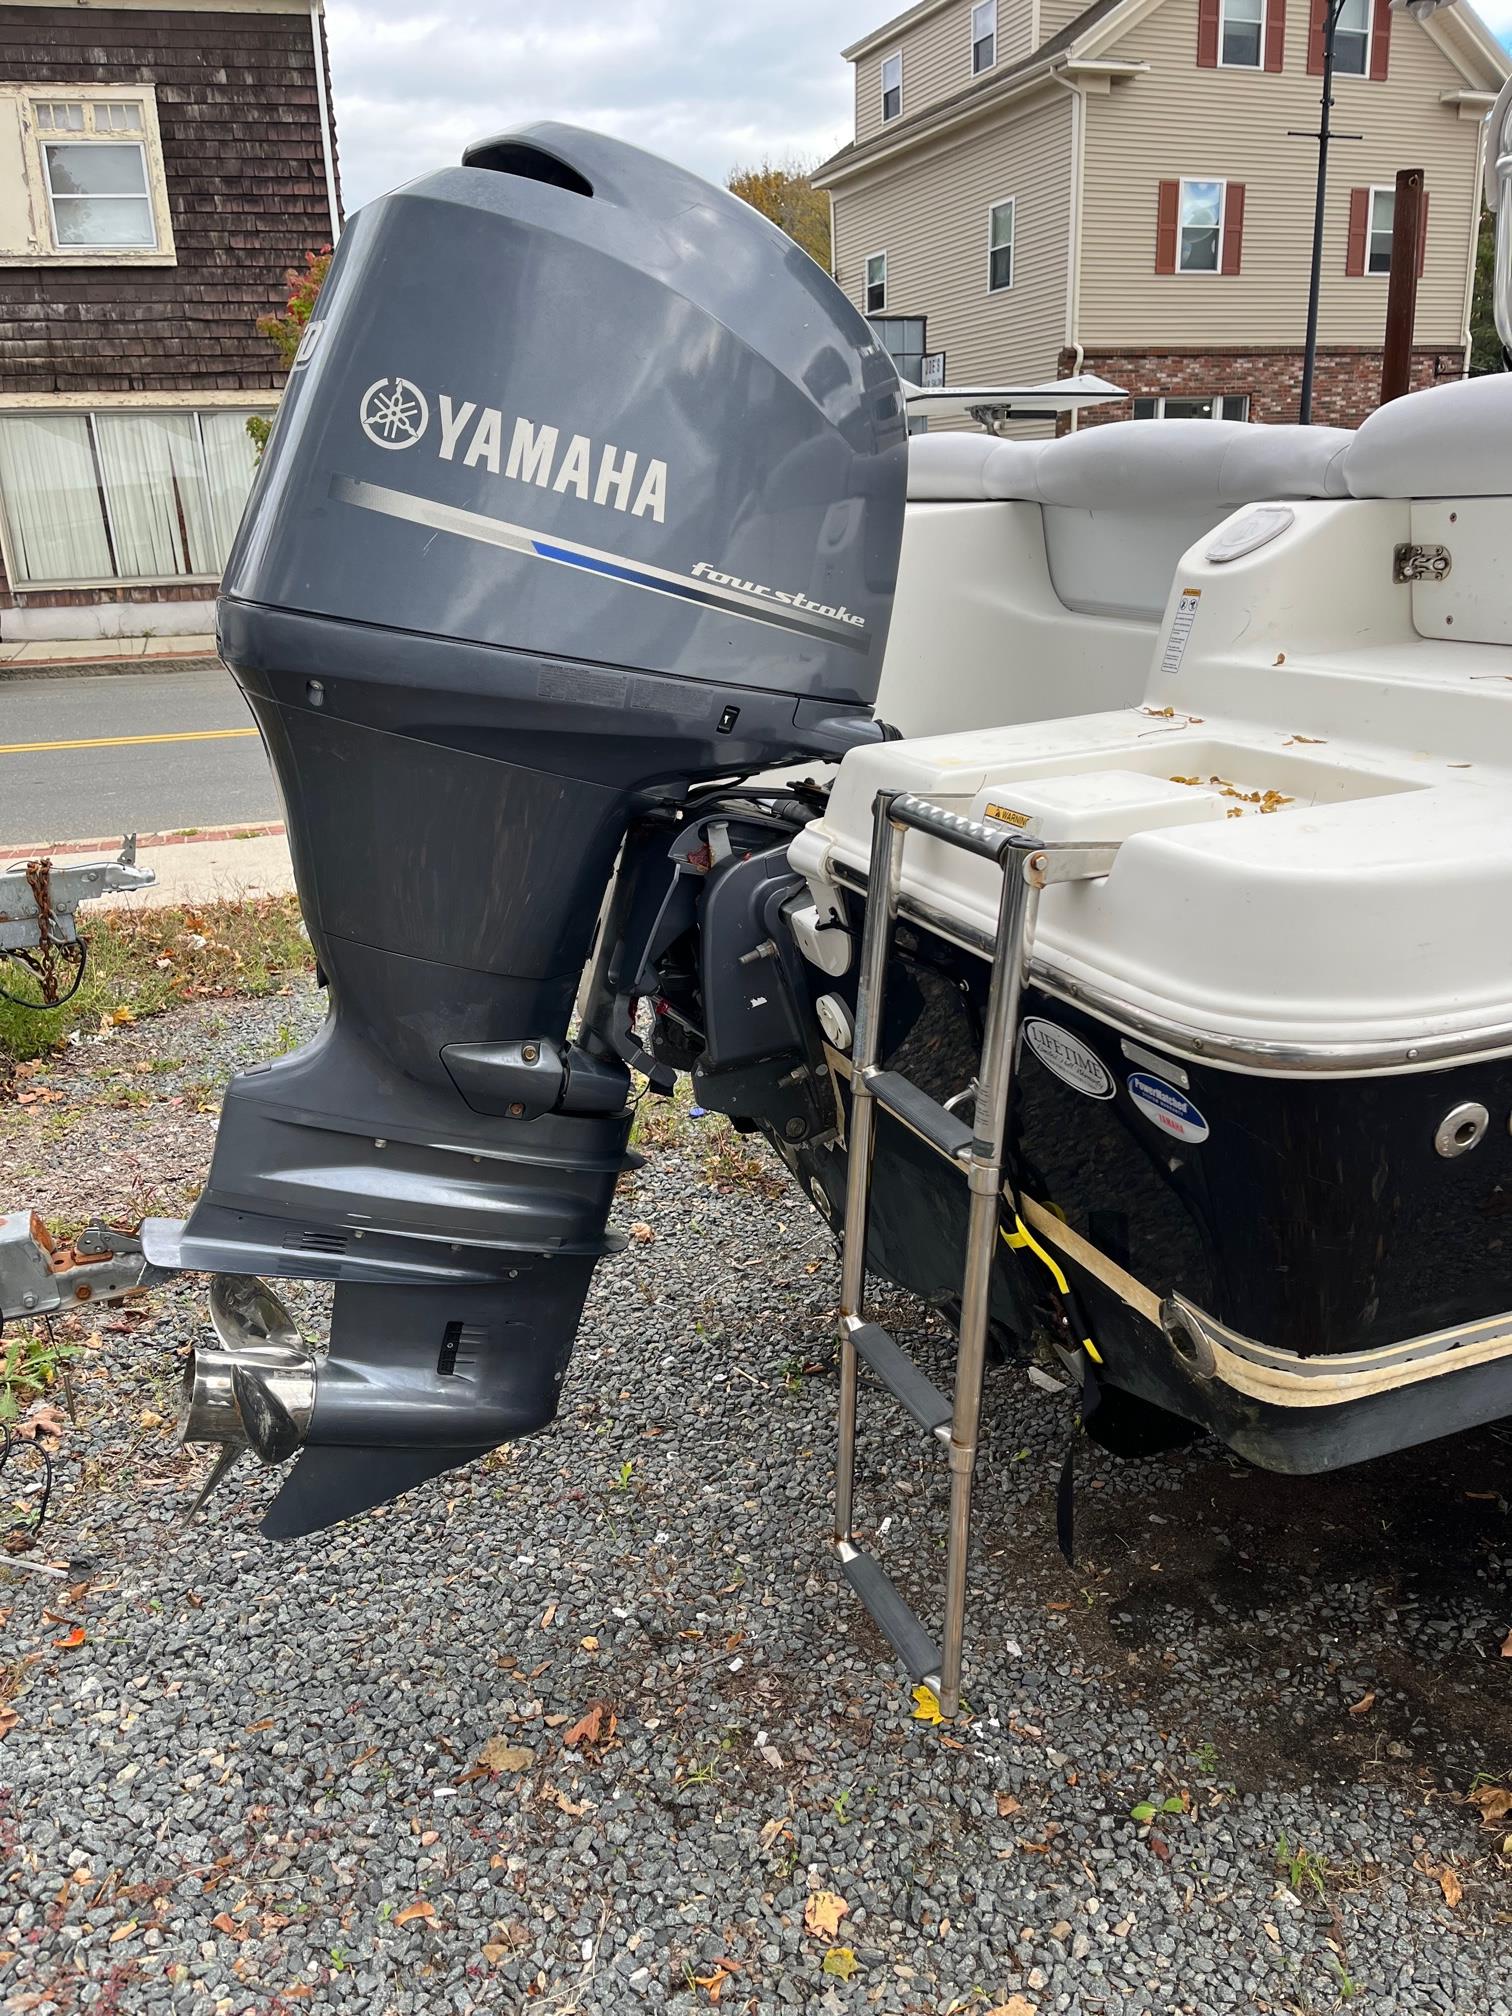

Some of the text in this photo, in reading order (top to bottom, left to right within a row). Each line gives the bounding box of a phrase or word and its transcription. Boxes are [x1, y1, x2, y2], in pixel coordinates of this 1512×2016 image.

[438, 394, 668, 524] YAMAHA
[1031, 1025, 1103, 1079] LIFETIME
[1156, 1113, 1186, 1134] YAMAHA
